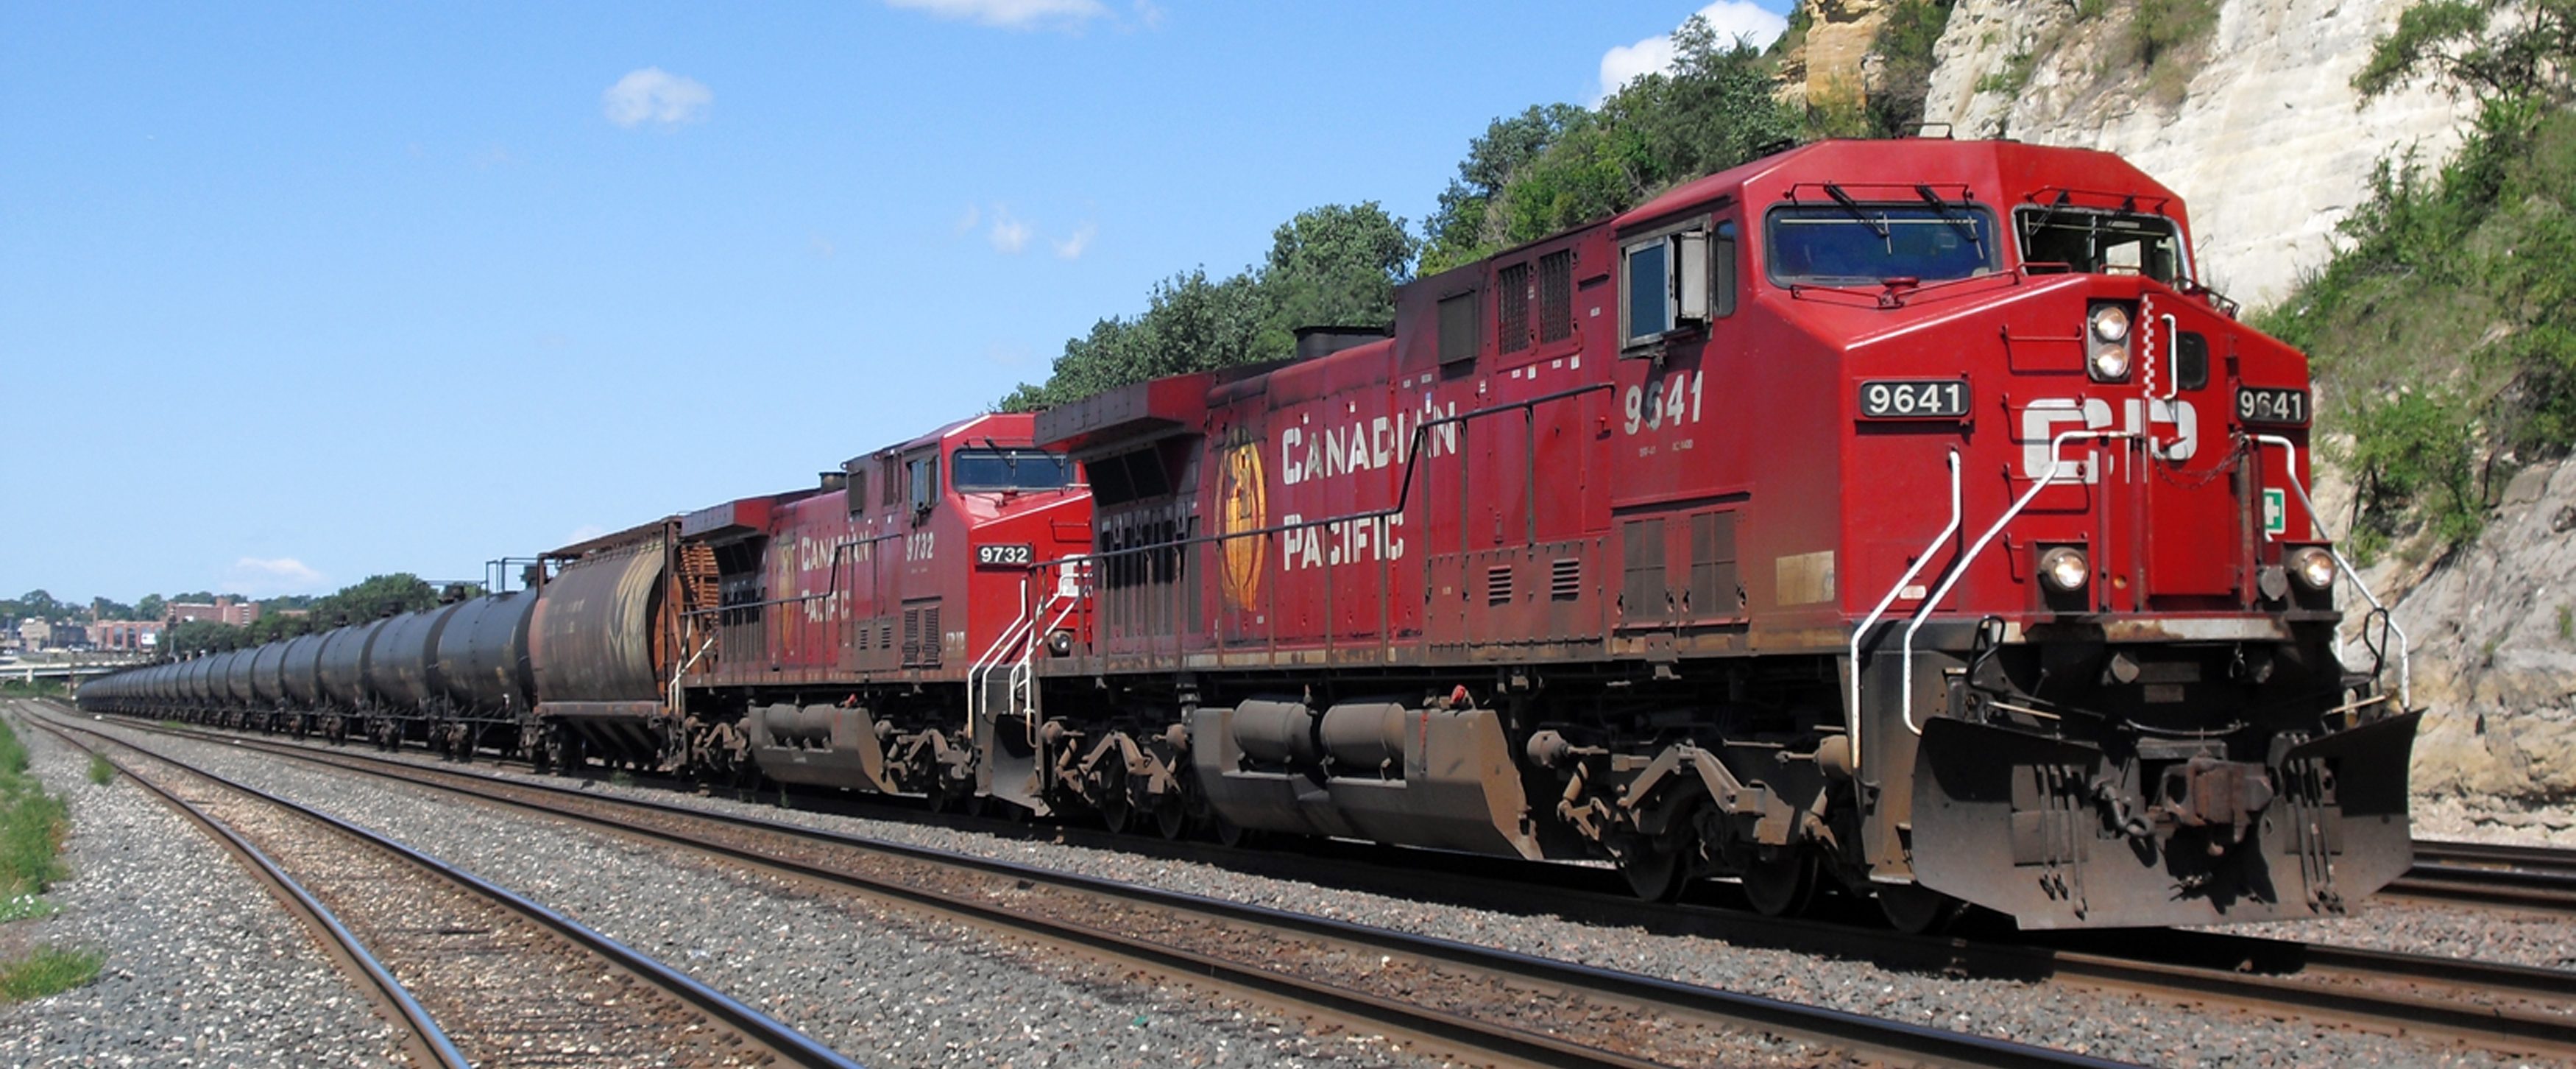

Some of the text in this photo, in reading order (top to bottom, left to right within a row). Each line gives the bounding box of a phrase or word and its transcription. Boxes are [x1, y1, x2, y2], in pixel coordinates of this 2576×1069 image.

[1624, 370, 1703, 435] 9641
[1869, 384, 1959, 413] 9641
[2240, 390, 2301, 420] 9641
[1282, 401, 1456, 485] CANADIAN
[2023, 398, 2198, 485] CP
[906, 532, 934, 562] 9732
[980, 547, 1027, 563] 9732
[1284, 512, 1404, 571] PACIFIC
[802, 589, 850, 624] PACIFC
